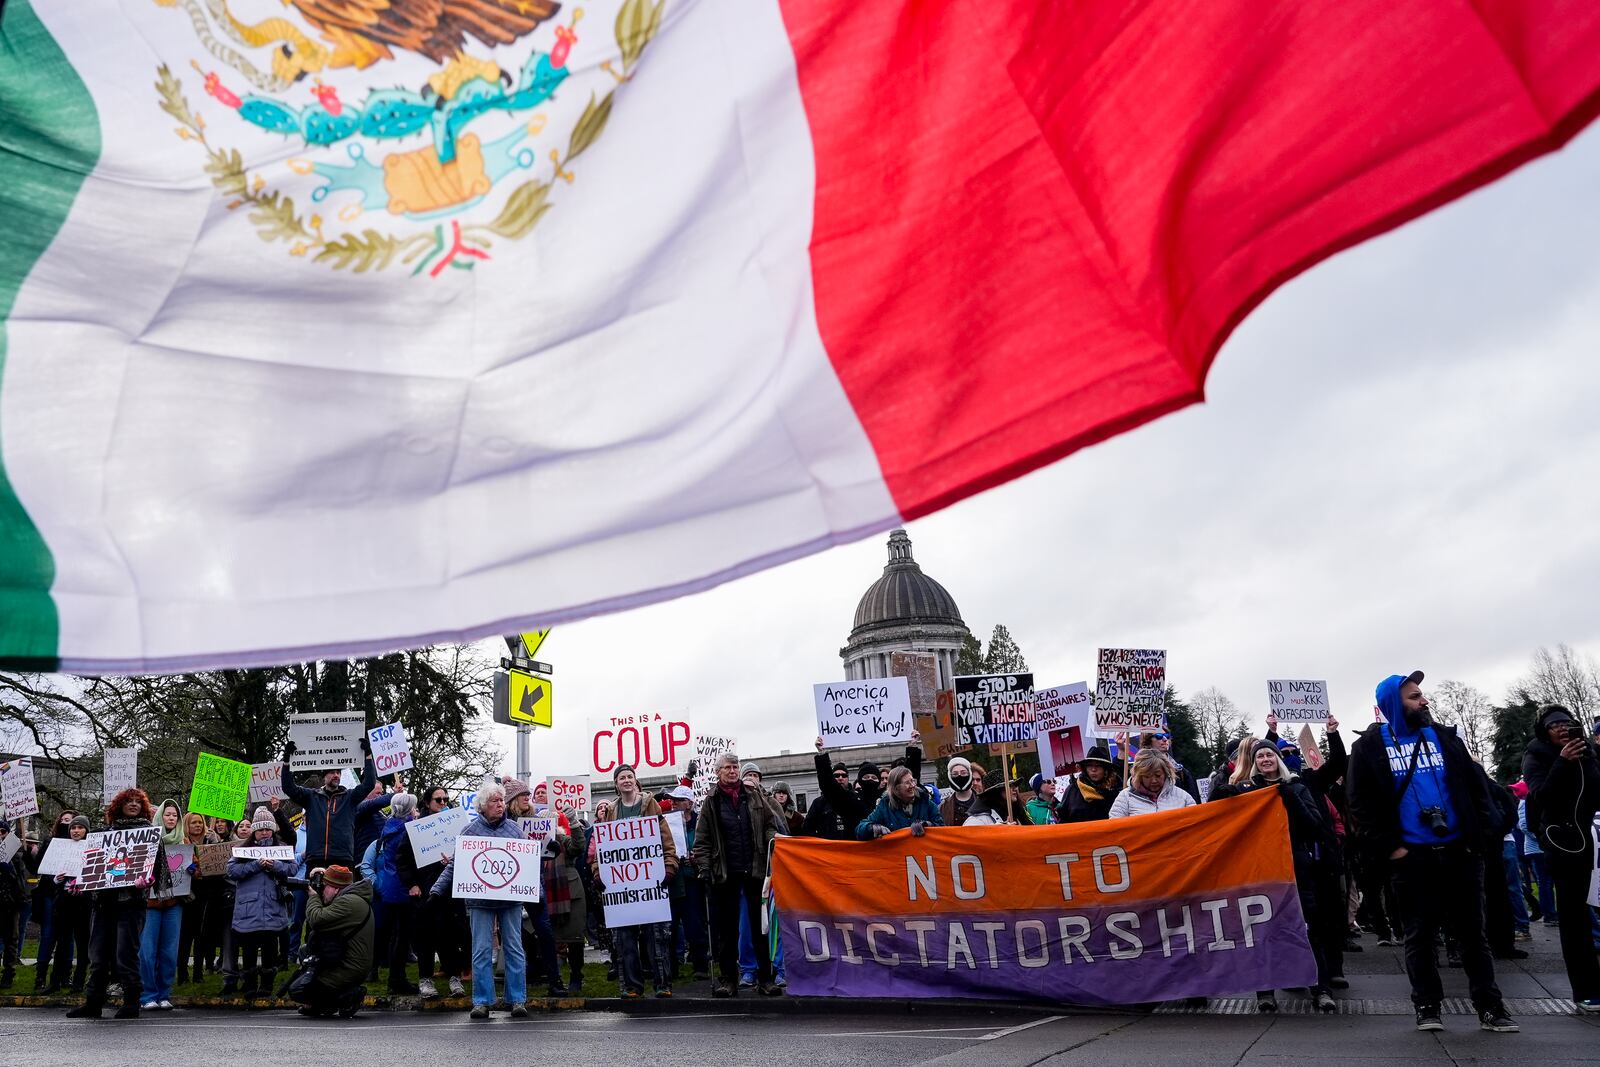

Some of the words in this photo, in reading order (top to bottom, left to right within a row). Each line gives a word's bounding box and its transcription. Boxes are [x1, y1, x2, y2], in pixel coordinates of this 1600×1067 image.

[824, 684, 888, 702] America
[974, 676, 1018, 695] STOP
[1269, 682, 1282, 693] NO
[1289, 682, 1322, 693] NAZIS
[957, 686, 1035, 709] PRETENDING
[1036, 692, 1087, 712] BILLIONAIRES
[1270, 694, 1285, 705] NO
[291, 718, 320, 726] KINDNESS
[331, 716, 366, 724] RESISTANCE
[610, 716, 634, 726] THIS
[639, 714, 649, 723] IS
[654, 712, 662, 721] A
[957, 707, 985, 726] YOUR
[990, 702, 1036, 724] RACISM
[1095, 712, 1133, 726] WHO'S
[1133, 713, 1163, 729] NEXT?
[821, 720, 850, 735] Have
[856, 722, 867, 734] a
[872, 711, 905, 738] King!
[1038, 715, 1069, 732] LOBBY.
[371, 725, 395, 743] STOP
[699, 736, 732, 750] ANGRY
[958, 727, 972, 746] IS
[973, 722, 1037, 745] PATRIOTISM
[593, 721, 691, 773] COUP
[697, 746, 732, 758] WOME
[291, 759, 317, 767] OUTLIVE
[337, 757, 357, 765] LOVE!
[376, 751, 407, 773] COUP
[251, 766, 282, 785] FUCK
[194, 782, 247, 817] TRUMP
[522, 819, 552, 833] MUSK
[595, 818, 658, 844] FIGHT
[102, 831, 122, 849] NO
[527, 832, 548, 842] MUST
[265, 848, 293, 858] HATE
[462, 840, 492, 850] RESIST!
[506, 841, 540, 856] RESIST!
[598, 843, 664, 865] ignorance
[481, 859, 514, 875] 2025
[610, 861, 653, 884] NOT
[905, 853, 987, 901] NO
[1044, 843, 1131, 902] TO
[457, 882, 487, 894] MUSK!
[797, 894, 1275, 971] DICTATORSHIP
